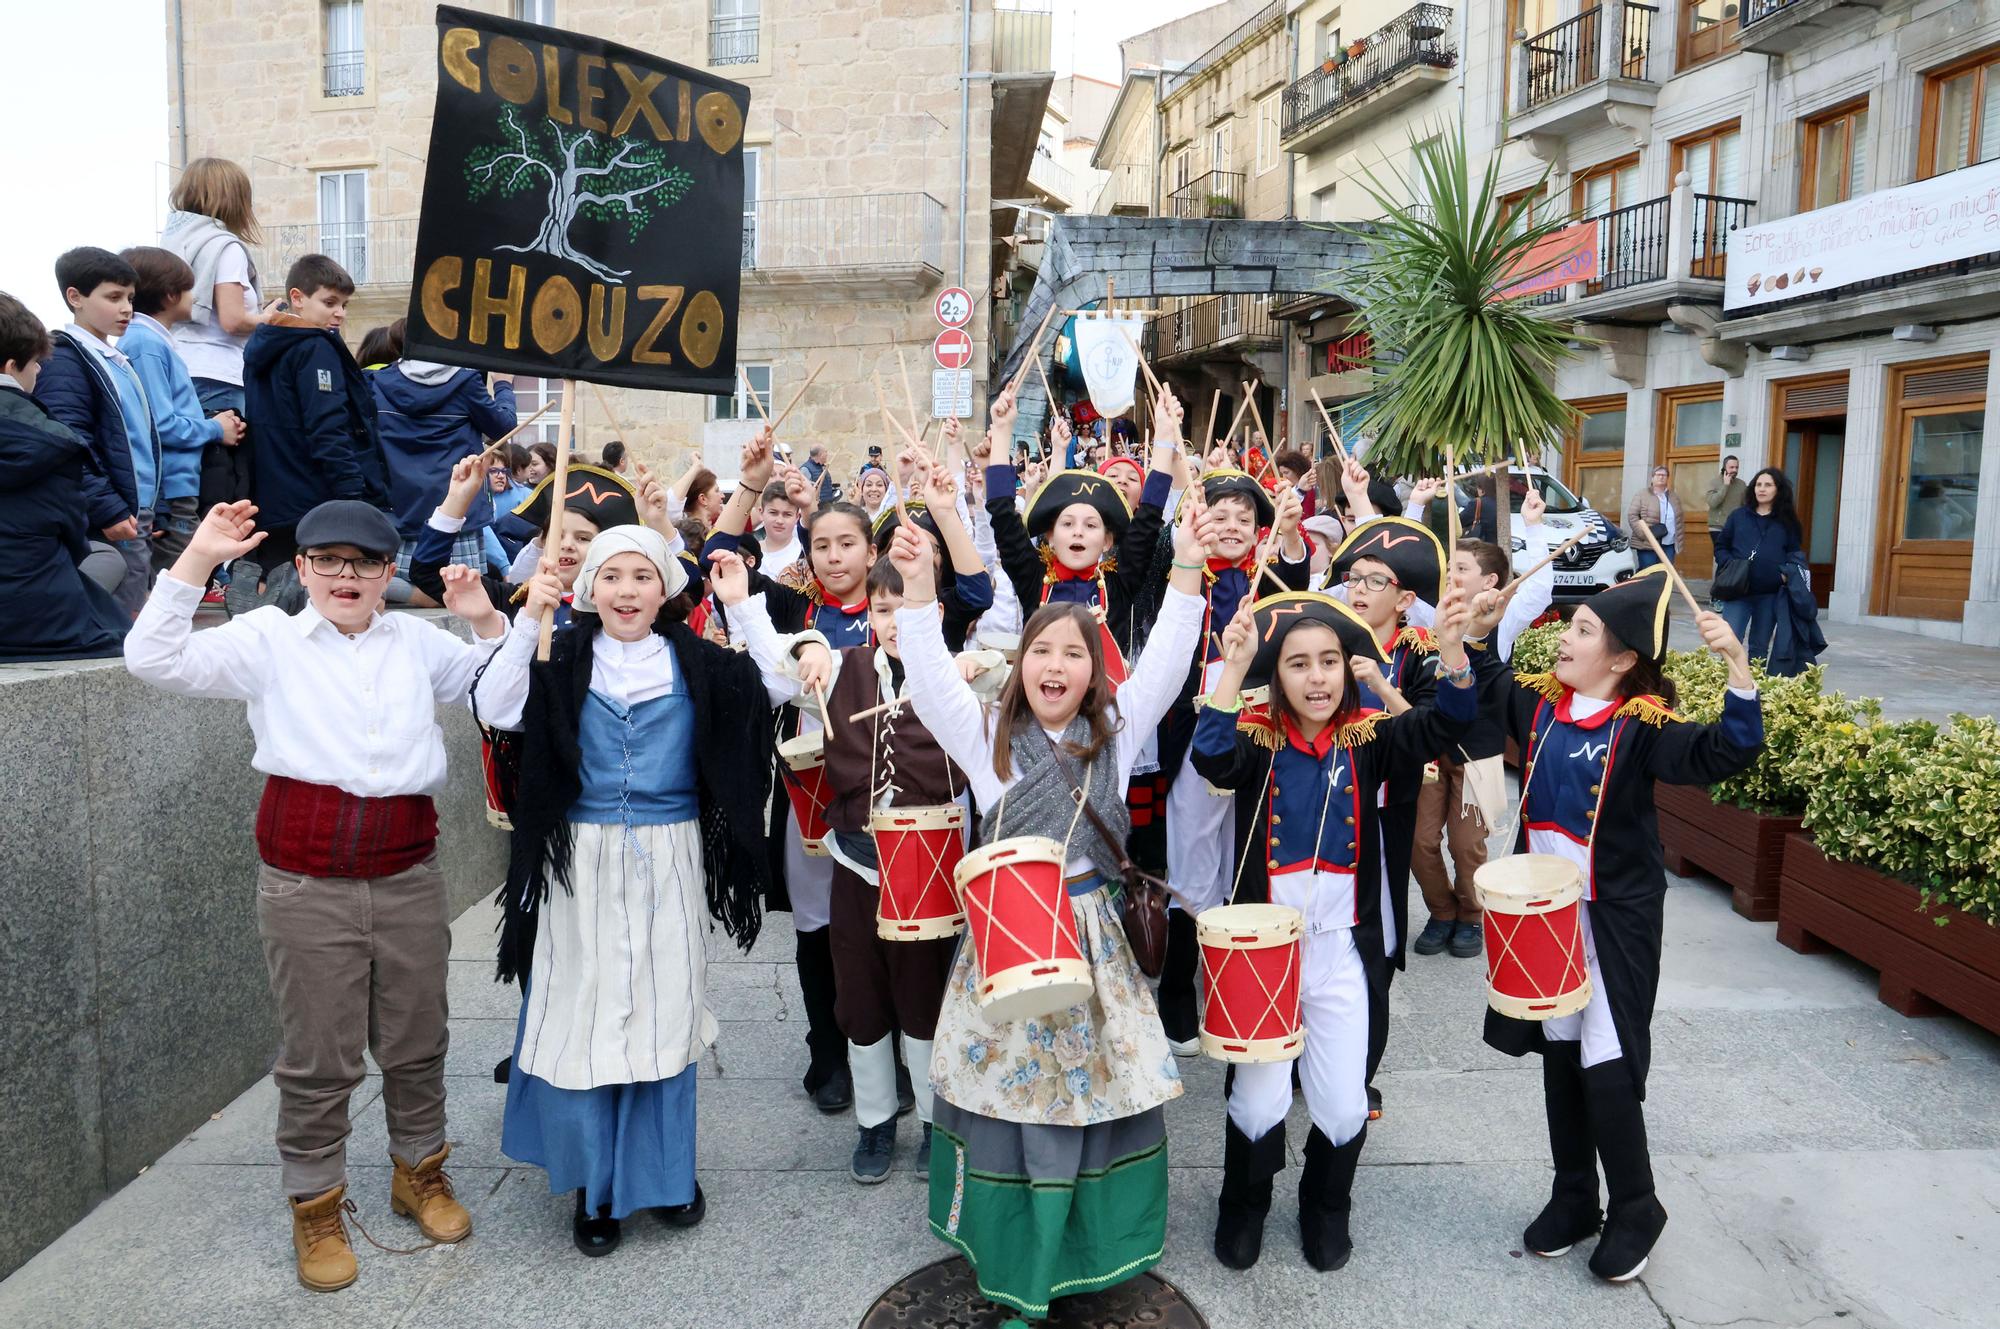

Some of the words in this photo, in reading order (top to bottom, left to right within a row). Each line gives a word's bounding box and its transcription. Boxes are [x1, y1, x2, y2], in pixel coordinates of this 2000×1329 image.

[442, 27, 743, 155] COLEXIO
[421, 256, 724, 368] CHOUZO
[1553, 575, 1575, 584] 4747
[1577, 575, 1594, 585] LVD
